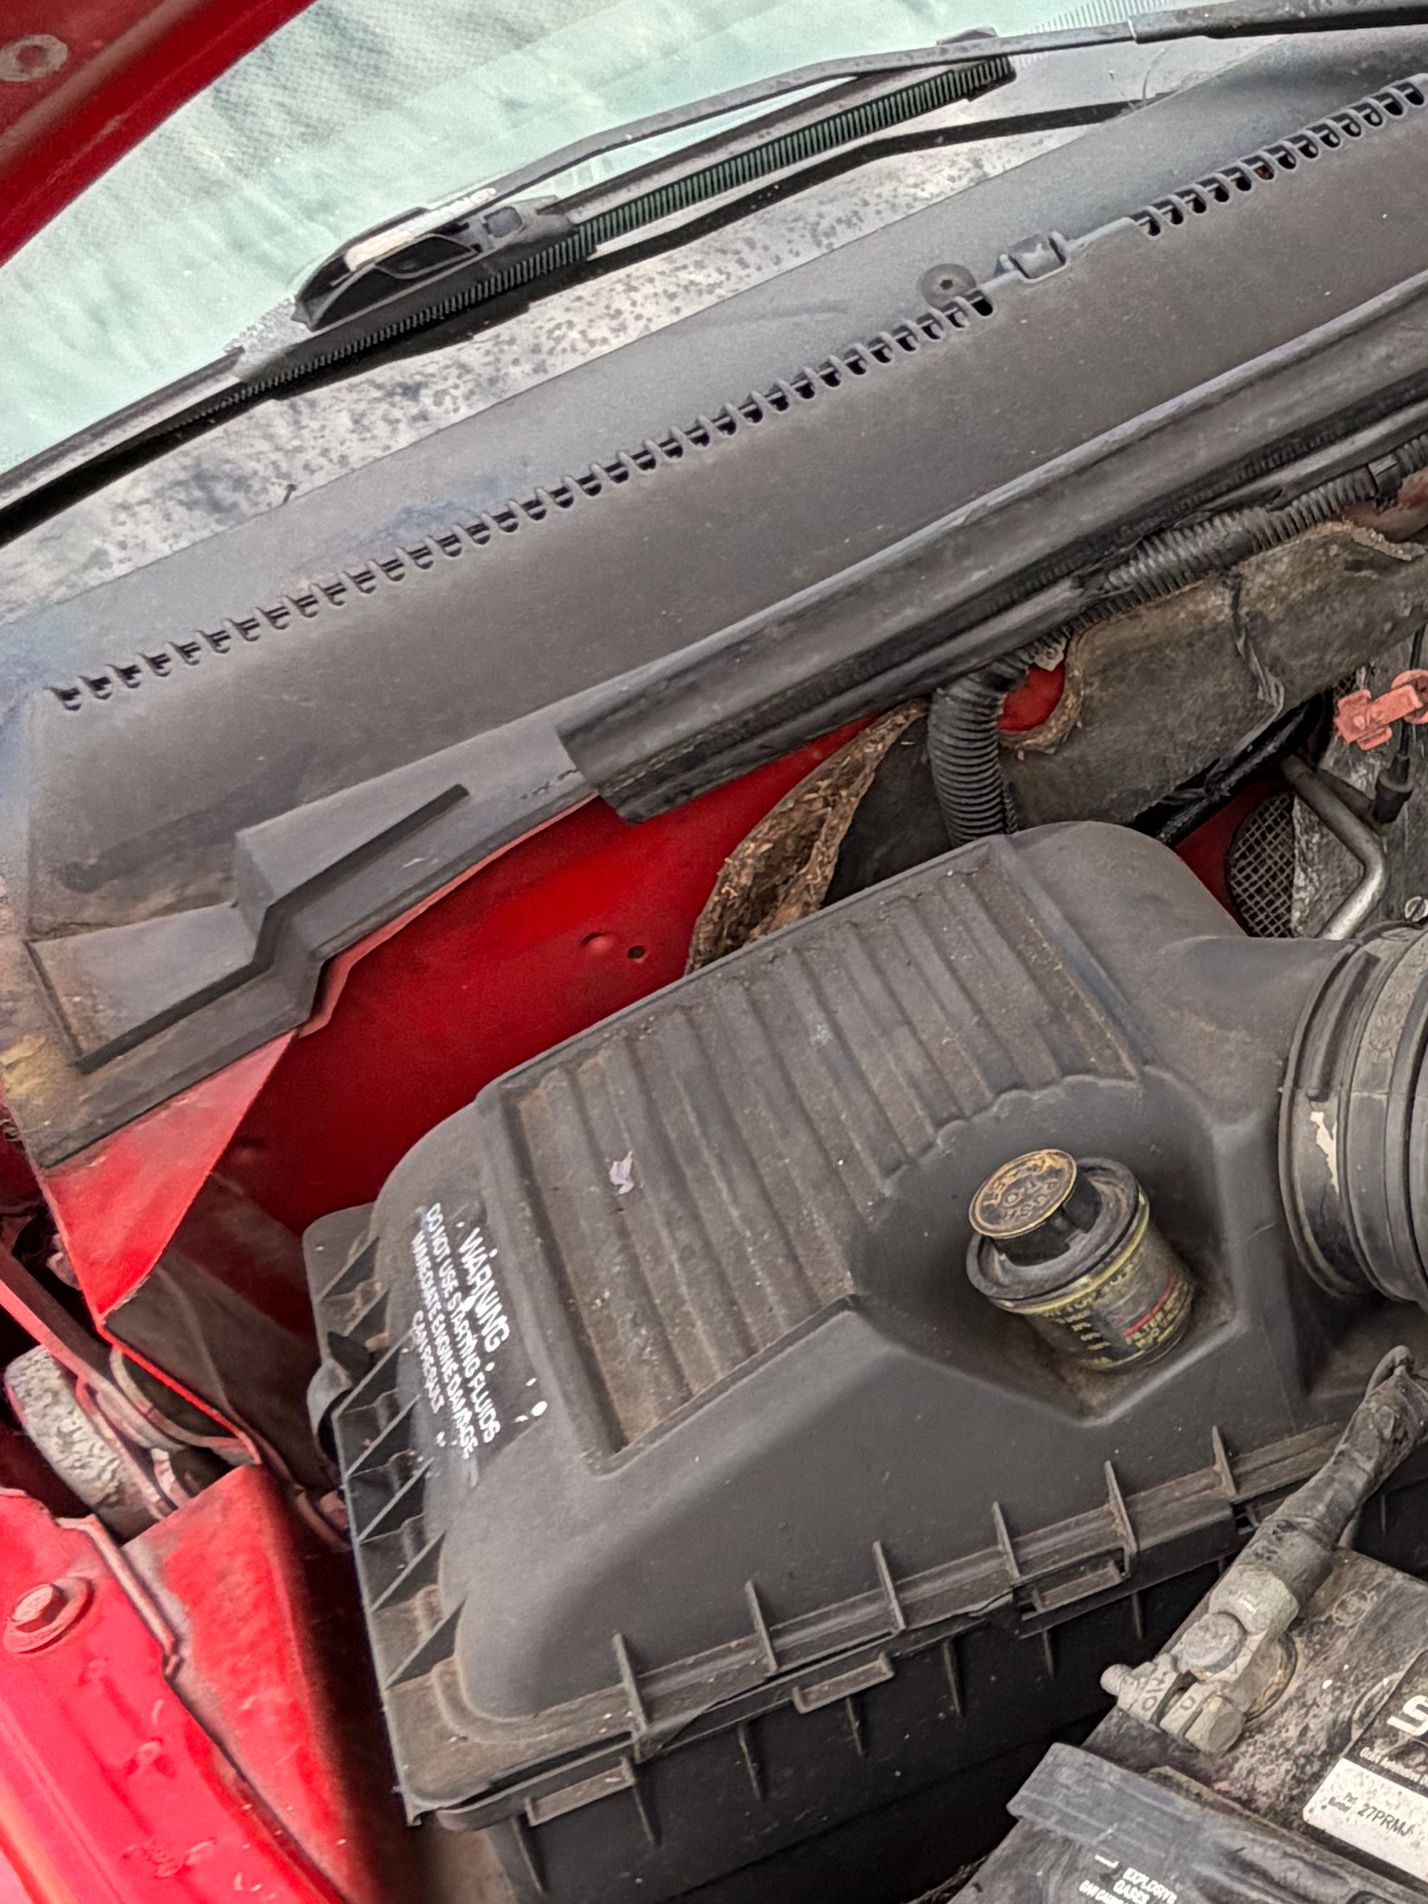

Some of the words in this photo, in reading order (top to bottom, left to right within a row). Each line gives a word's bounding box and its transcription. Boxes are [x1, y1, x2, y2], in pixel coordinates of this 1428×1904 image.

[426, 1201, 444, 1230] DO
[431, 1224, 451, 1263] NOT
[438, 1258, 459, 1298] USE
[459, 1226, 510, 1352] WARNING
[410, 1230, 442, 1322] IMMEDIATE
[430, 1312, 458, 1383] ENGINE
[446, 1374, 479, 1459] DAMAGE
[448, 1291, 481, 1379] STARTING
[467, 1370, 501, 1444] FLUIDS
